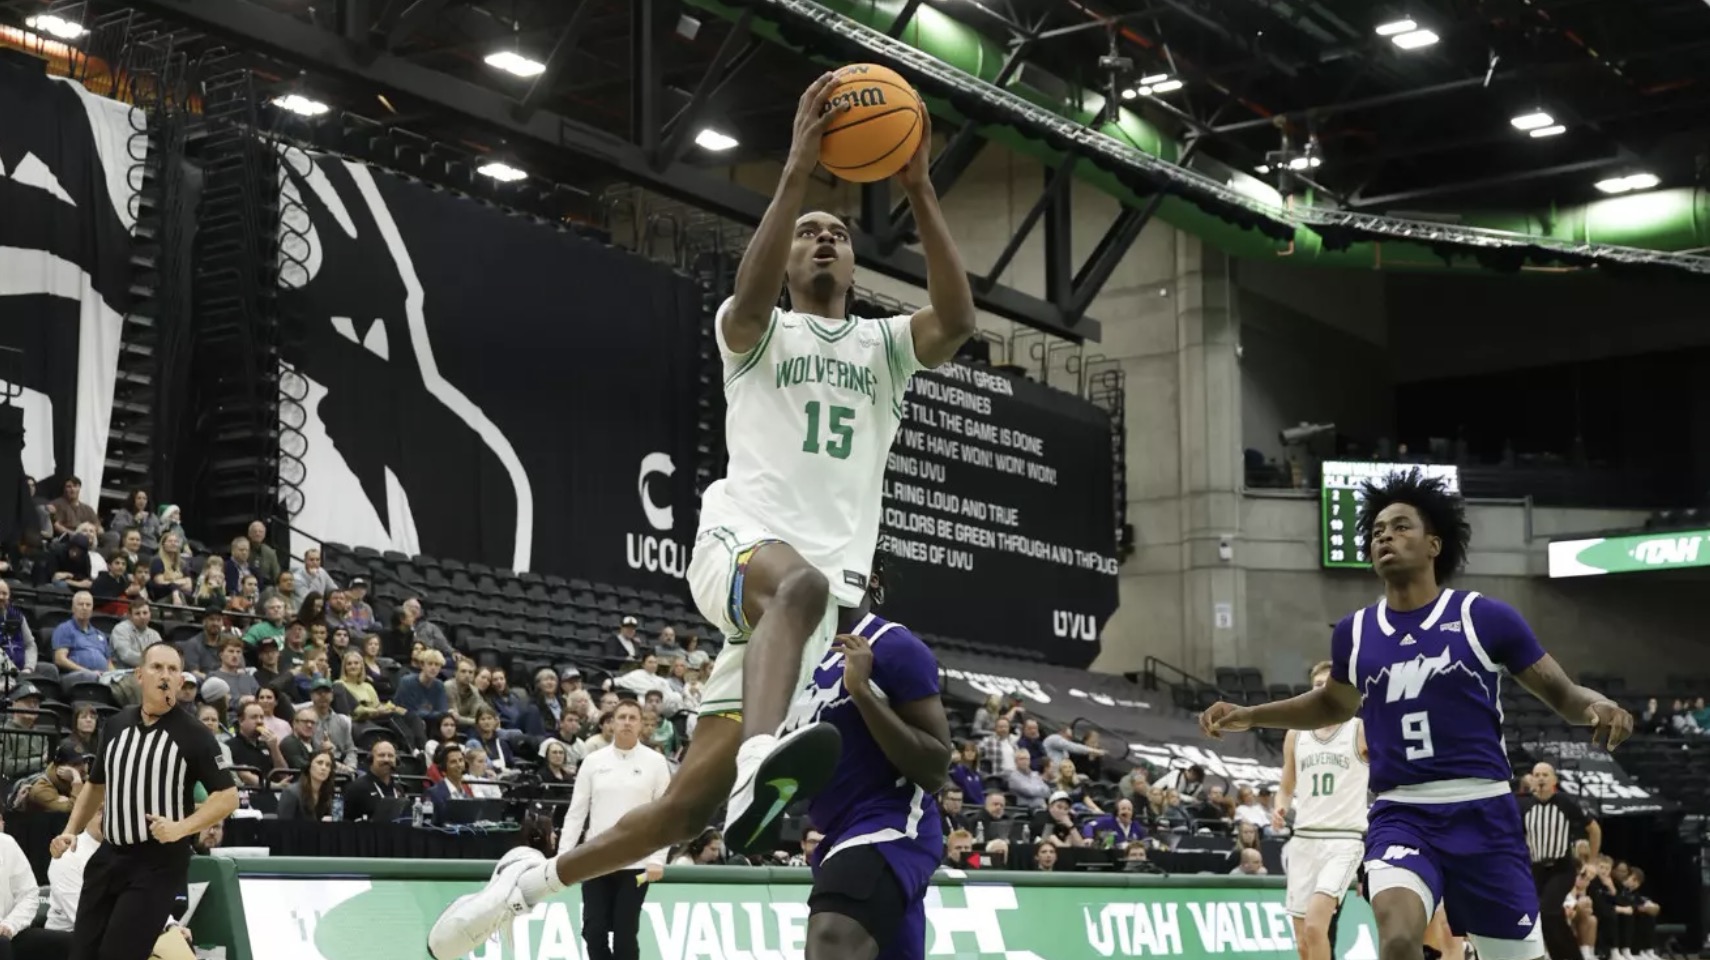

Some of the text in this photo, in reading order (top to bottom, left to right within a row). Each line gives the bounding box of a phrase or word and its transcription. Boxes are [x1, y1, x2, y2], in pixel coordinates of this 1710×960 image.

[915, 377, 991, 415] WOLVERINES
[973, 370, 1013, 396] GREEN
[802, 401, 856, 460] 15
[911, 402, 937, 427] TILL
[939, 410, 963, 434] THE
[965, 418, 999, 444] GAME
[1000, 428, 1012, 447] IS
[1012, 430, 1044, 457] DONE
[887, 452, 946, 483] SING UVU
[904, 428, 925, 451] WE
[926, 434, 959, 460] HAVE
[960, 443, 993, 468] WON!
[994, 453, 1026, 476] WON!
[1026, 461, 1057, 485] WON!
[895, 481, 925, 506] RING
[926, 489, 959, 514] LOUD
[961, 498, 987, 520] AND
[988, 504, 1019, 527] TRUE
[885, 507, 935, 536] COLORS
[937, 519, 953, 540] BE
[955, 523, 995, 549] GREEN
[929, 544, 945, 565] OF
[947, 549, 973, 571] UVU
[1053, 609, 1097, 641] UVU
[1401, 711, 1434, 761] 9
[1312, 773, 1334, 797] 10
[641, 903, 811, 960] VALLE
[1084, 902, 1297, 955] UTAH VALLE
